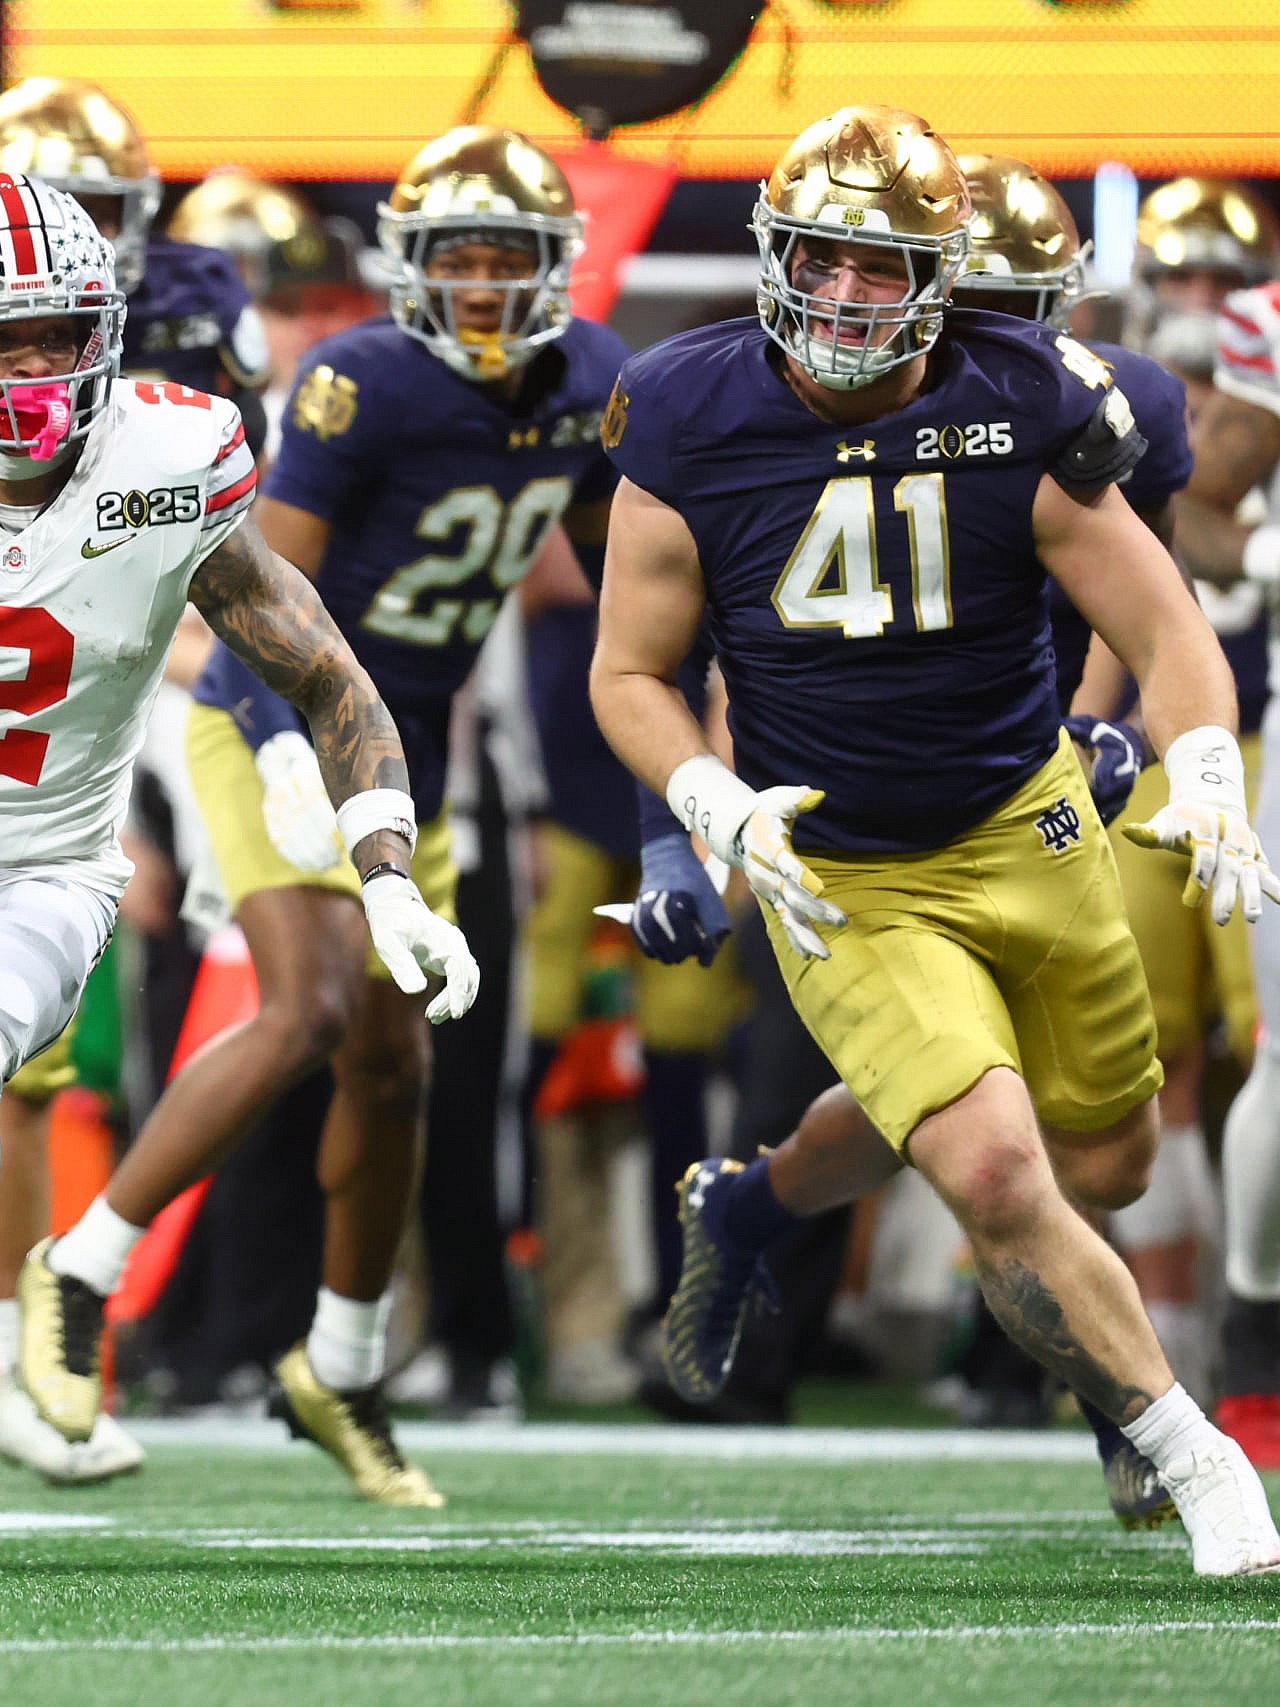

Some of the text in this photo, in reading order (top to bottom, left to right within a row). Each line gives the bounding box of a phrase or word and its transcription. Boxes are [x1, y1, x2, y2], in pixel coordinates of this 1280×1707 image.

[915, 421, 1014, 460] 2025
[96, 485, 201, 531] 2025
[360, 475, 573, 647] 29
[770, 472, 954, 640] 41
